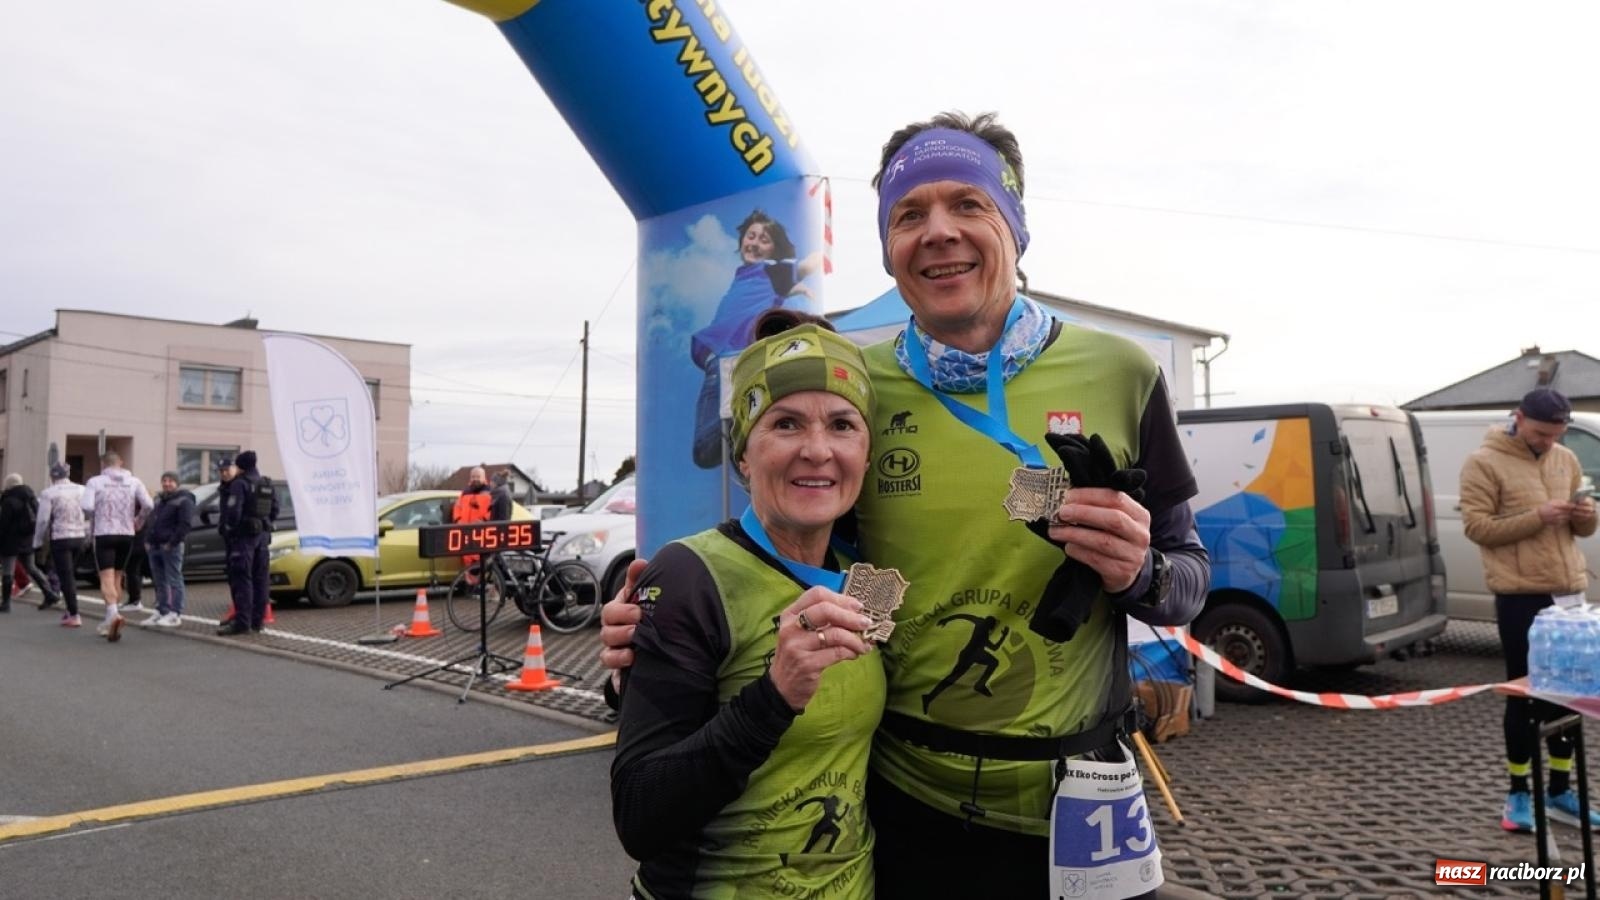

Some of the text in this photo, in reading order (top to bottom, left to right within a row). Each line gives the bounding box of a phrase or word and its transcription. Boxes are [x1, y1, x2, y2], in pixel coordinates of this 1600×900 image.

[646, 0, 773, 175] tywnych
[733, 46, 799, 149] ludzi
[878, 474, 921, 494] HOSTERSI
[448, 524, 532, 551] 0:45:35
[951, 588, 1011, 610] GRUPA
[1075, 769, 1091, 779] Eko
[1092, 771, 1119, 781] Cross
